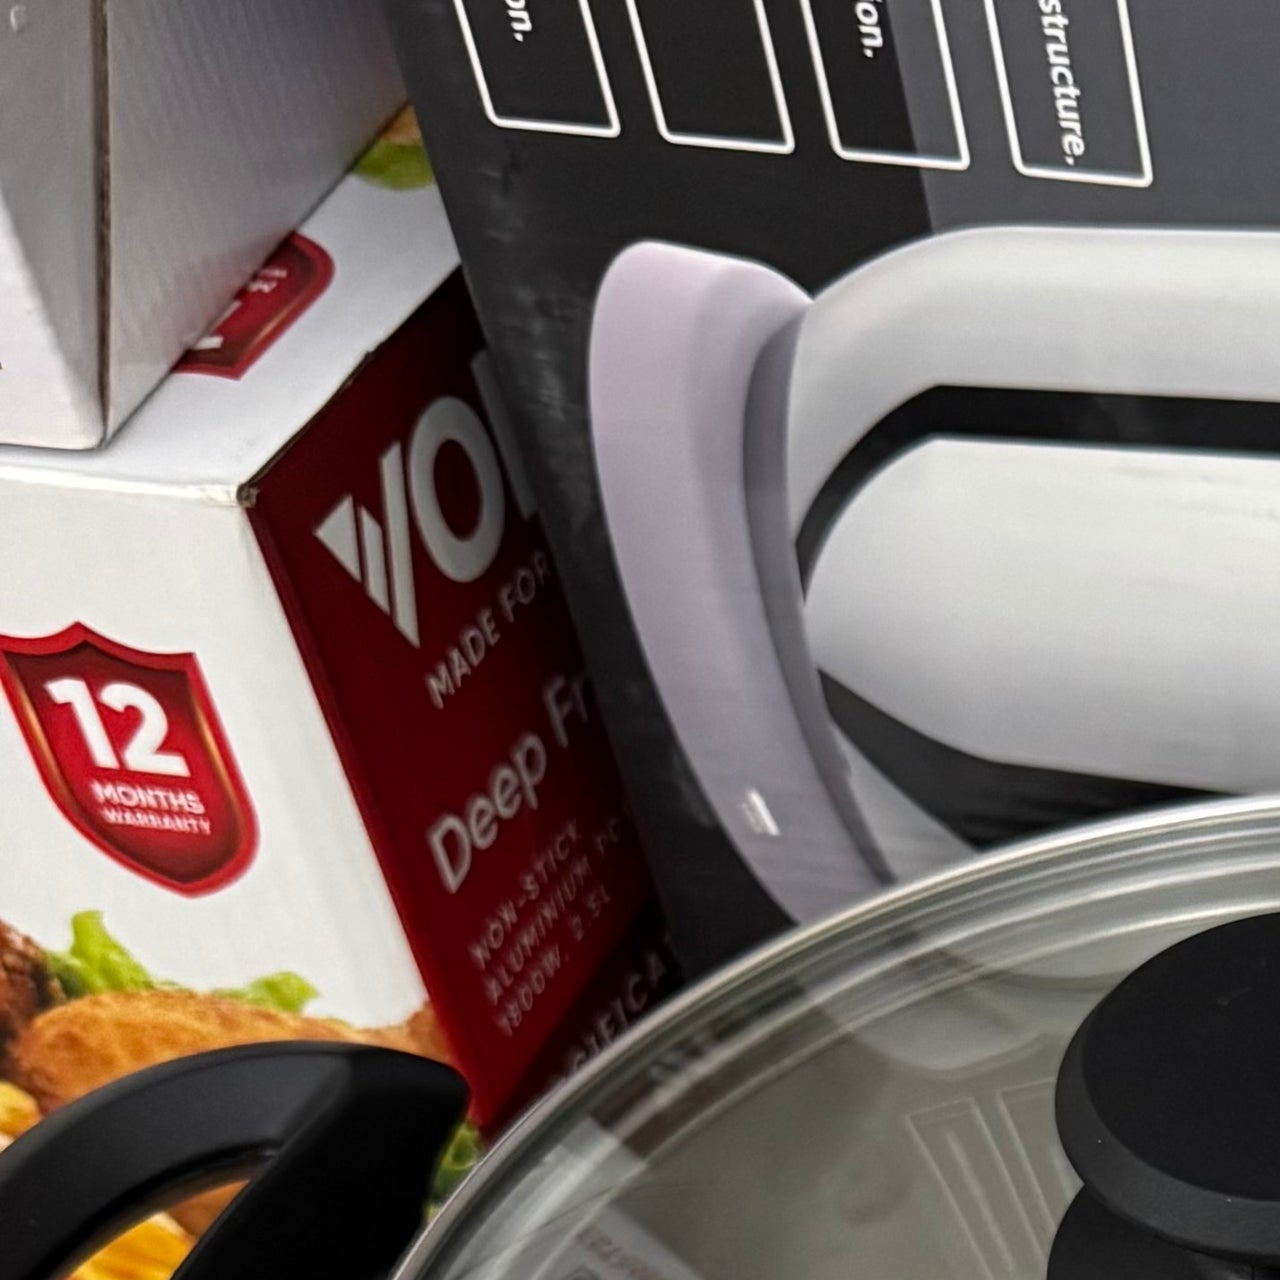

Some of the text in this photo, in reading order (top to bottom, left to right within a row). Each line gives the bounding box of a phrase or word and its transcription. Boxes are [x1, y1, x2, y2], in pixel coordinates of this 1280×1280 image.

[424, 607, 501, 710] MADE
[44, 677, 191, 777] 12
[90, 780, 206, 815] MONTHS
[100, 806, 212, 836] WARRANTY
[425, 731, 548, 895] Deep
